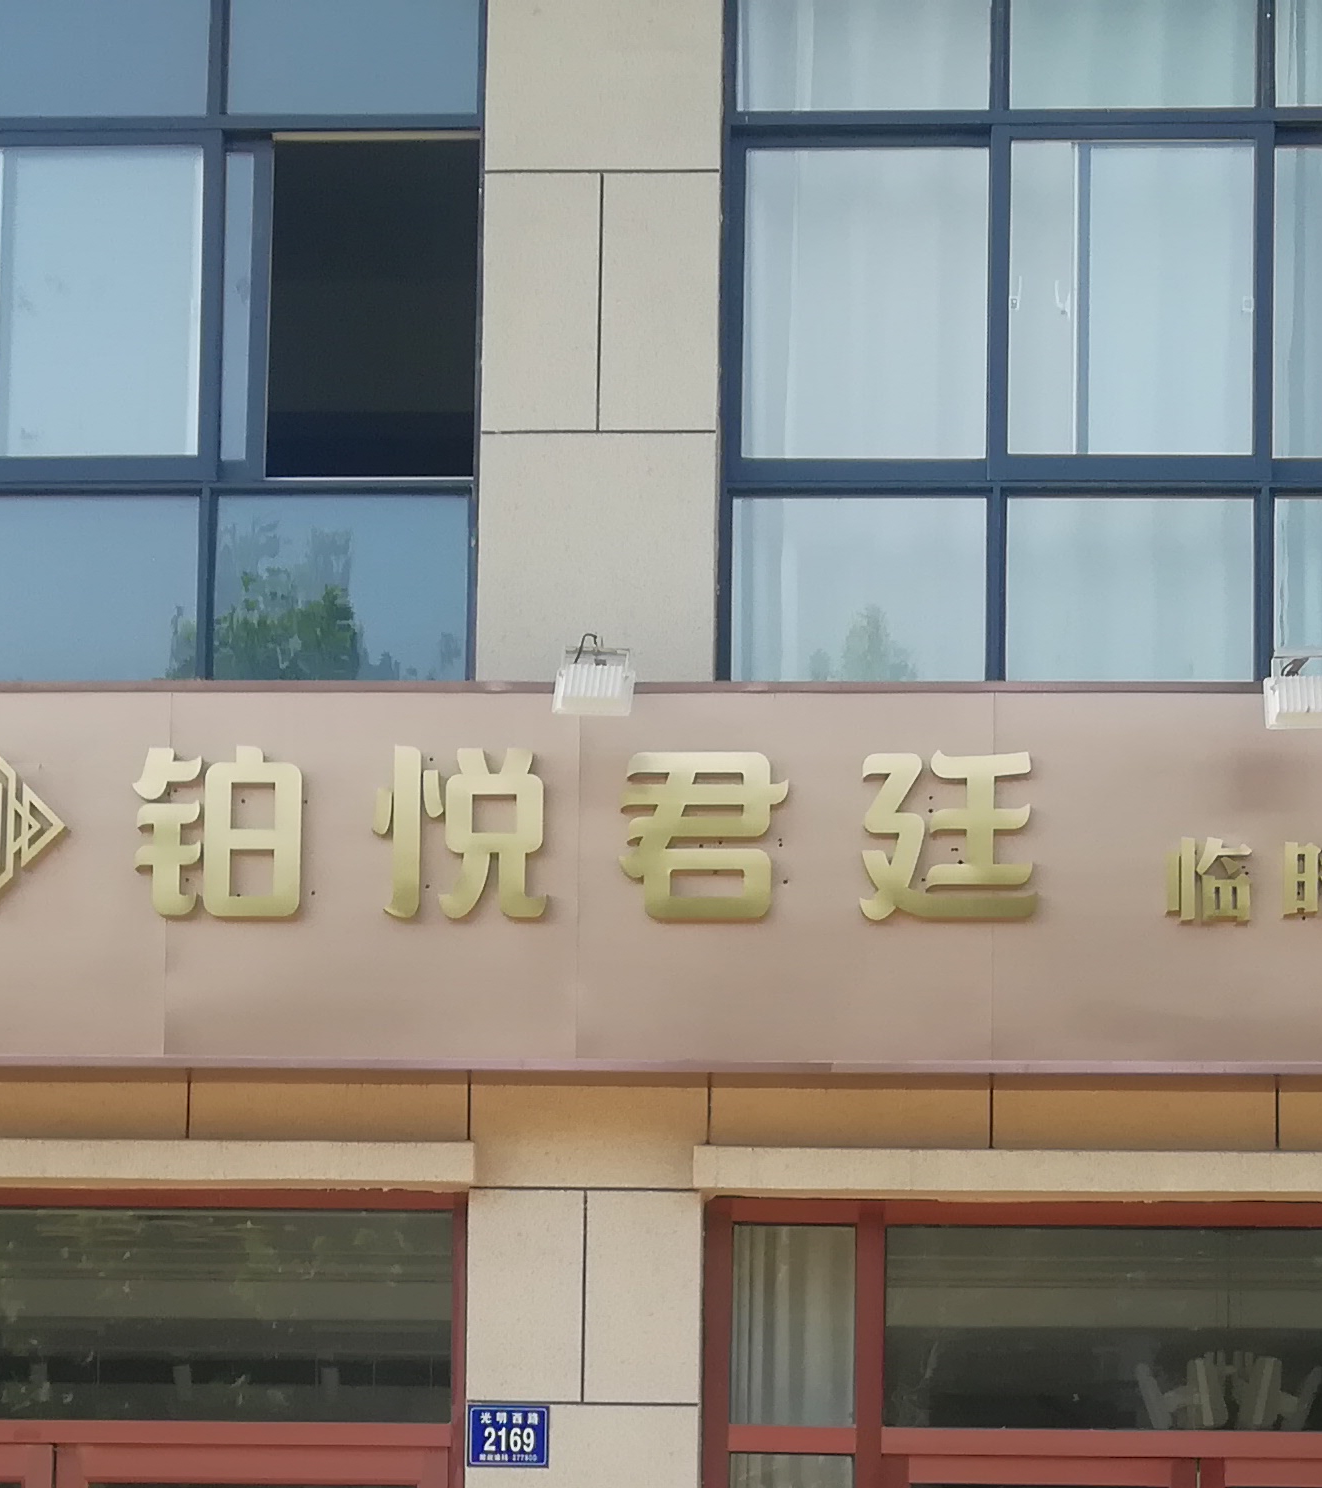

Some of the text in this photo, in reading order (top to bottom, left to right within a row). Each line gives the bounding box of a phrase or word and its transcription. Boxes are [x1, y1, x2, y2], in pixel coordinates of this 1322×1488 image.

[131, 743, 1039, 921] 铂悦君廷
[480, 1411, 539, 1425] 光明西路
[483, 1427, 535, 1452] 2169
